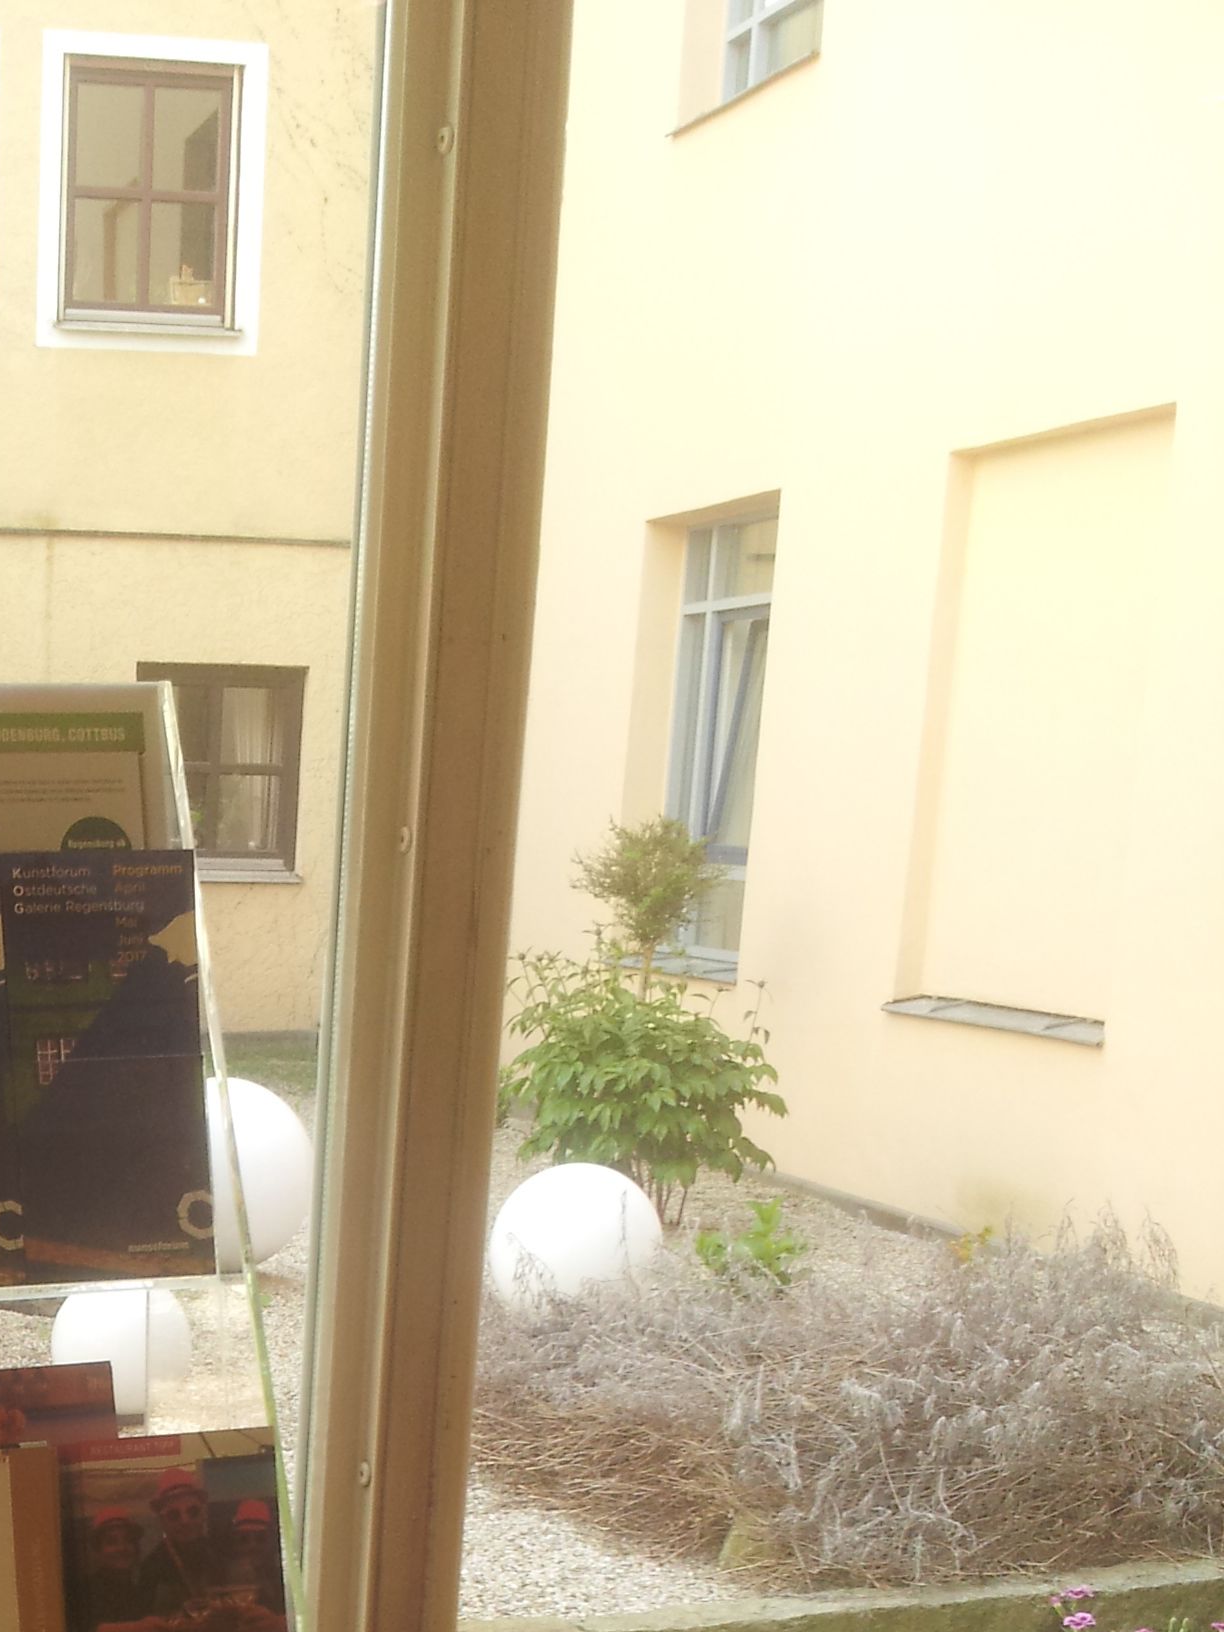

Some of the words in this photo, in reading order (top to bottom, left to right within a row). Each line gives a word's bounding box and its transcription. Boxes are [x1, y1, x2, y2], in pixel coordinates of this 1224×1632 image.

[68, 726, 126, 742] COTTBUS
[12, 866, 91, 880] Kunstforum
[112, 864, 183, 877] Programm
[13, 884, 97, 898] Ostdeutsche
[13, 902, 62, 916] Galerie
[65, 899, 145, 915] Regensburg
